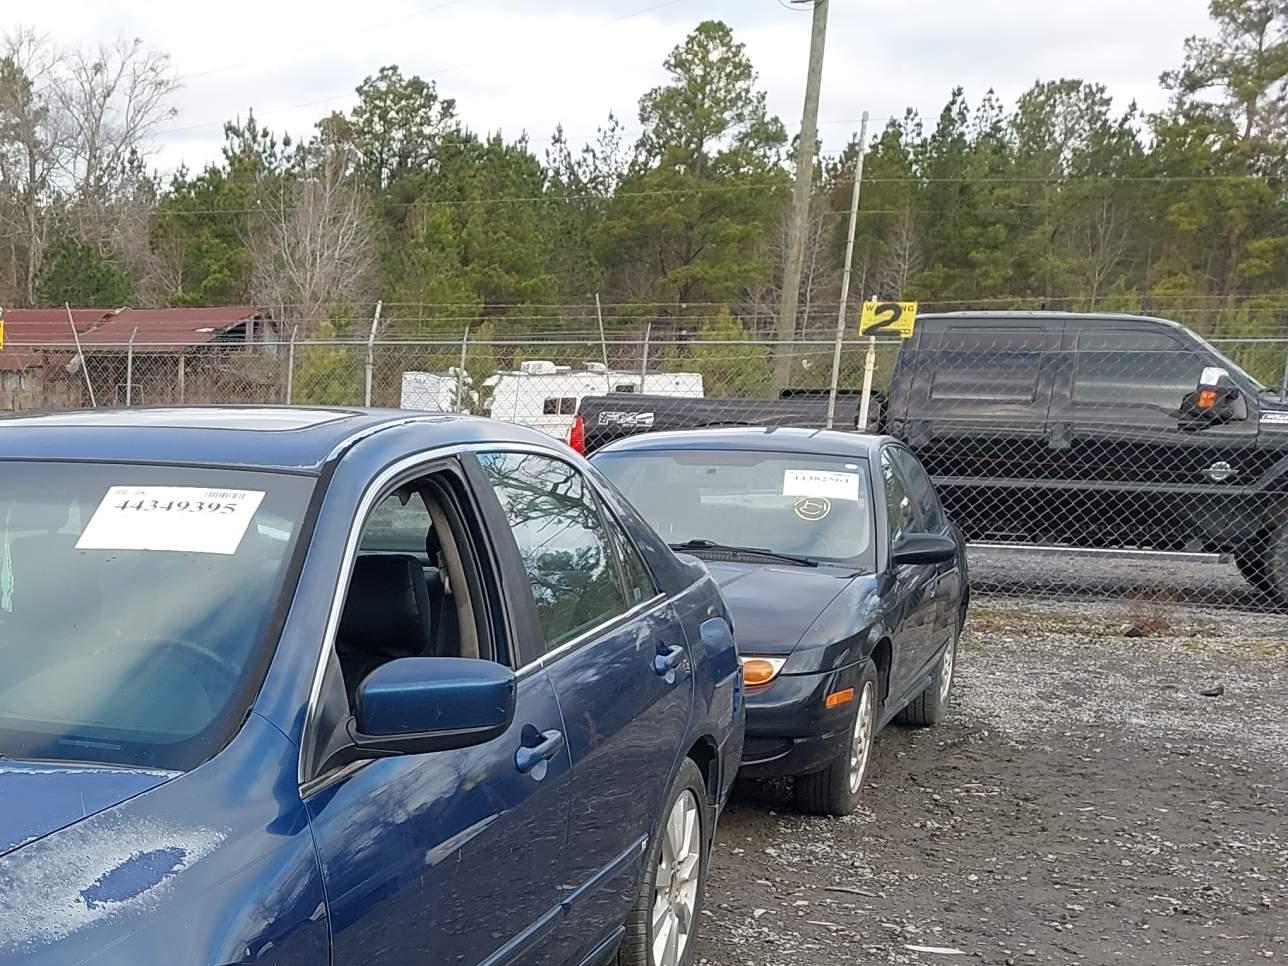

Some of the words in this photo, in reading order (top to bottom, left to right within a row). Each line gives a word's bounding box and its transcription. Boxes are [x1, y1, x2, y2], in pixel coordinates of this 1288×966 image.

[863, 303, 902, 337] 2
[598, 411, 654, 425] FX4
[114, 499, 238, 514] 44349395
